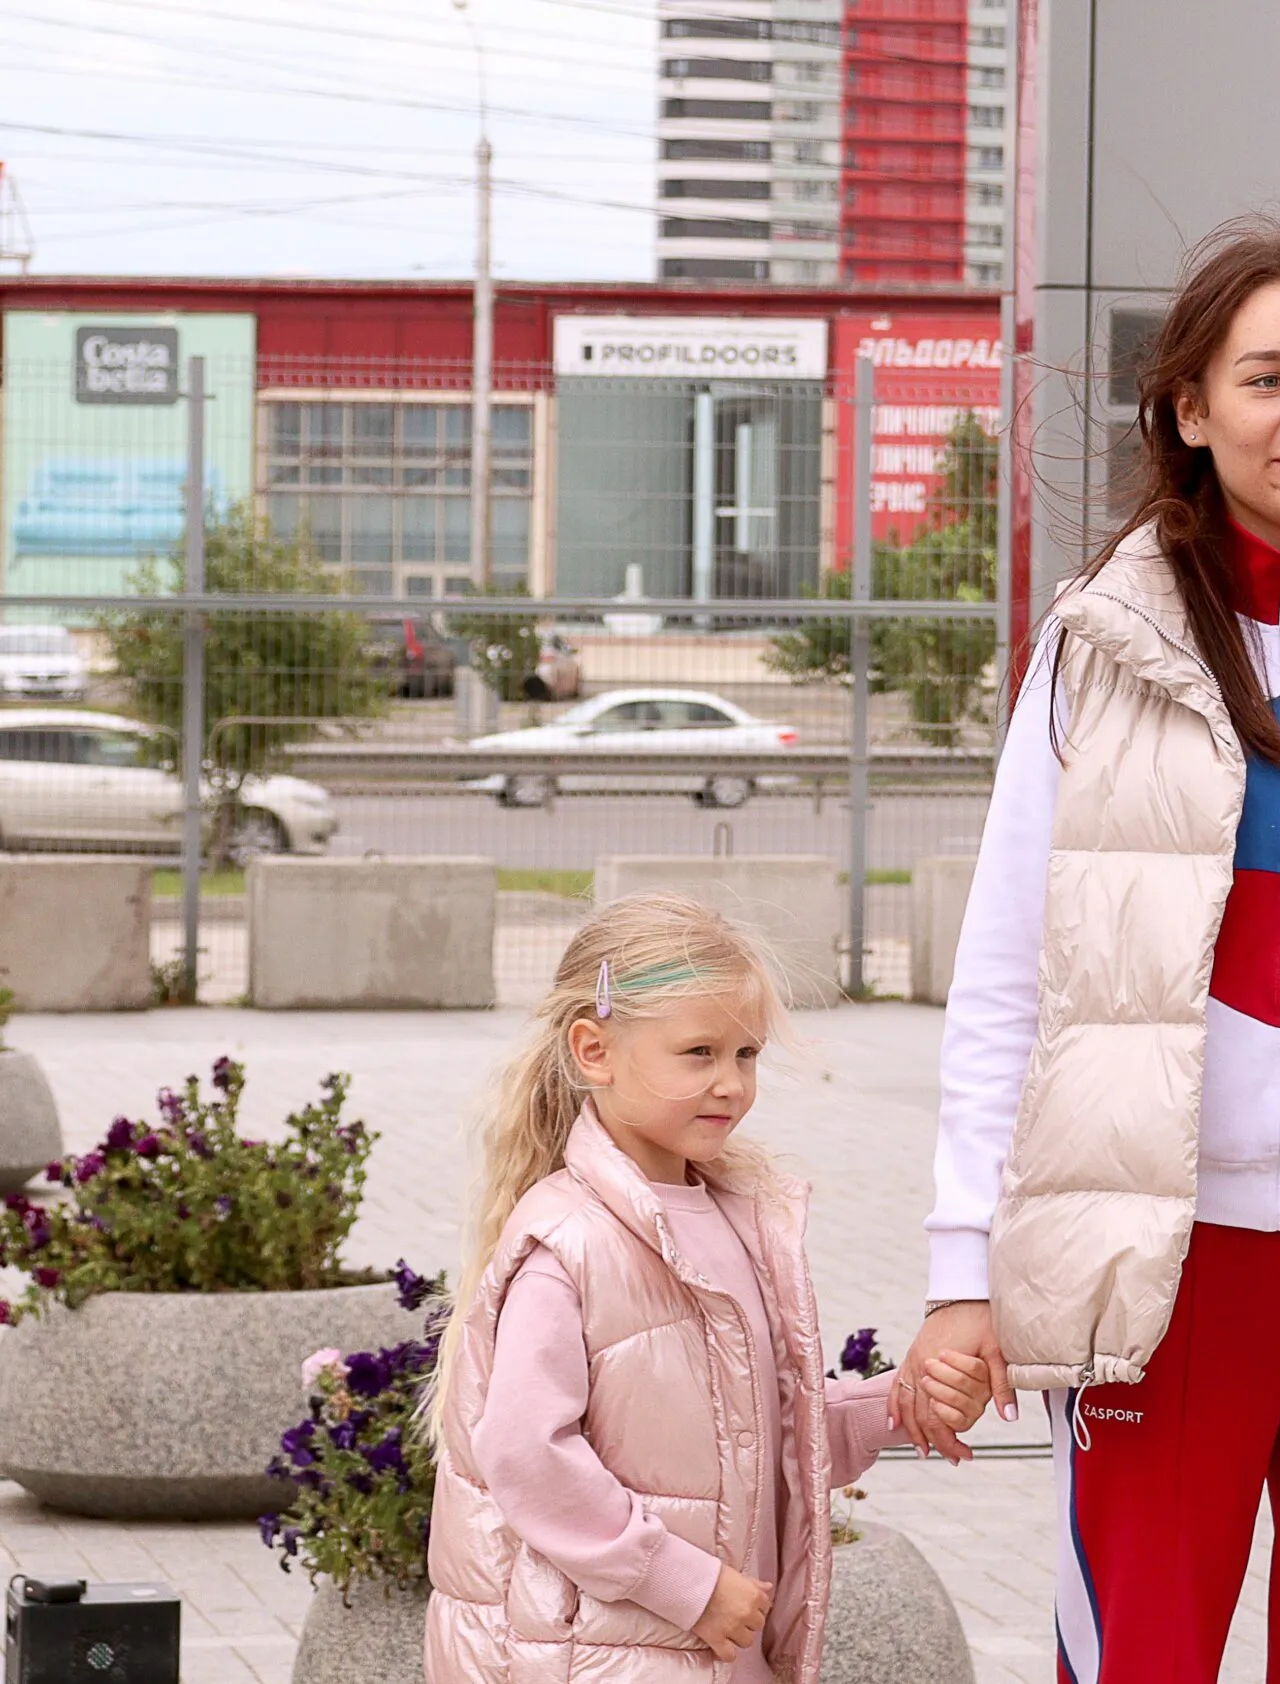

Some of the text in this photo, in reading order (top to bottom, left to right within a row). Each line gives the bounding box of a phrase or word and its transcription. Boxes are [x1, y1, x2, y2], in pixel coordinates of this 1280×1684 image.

[83, 335, 169, 367] Costa
[601, 343, 797, 364] PROFILDOORS
[854, 337, 1003, 368] ЭЛЬДОРАД
[86, 365, 168, 393] bella
[1084, 1403, 1144, 1424] ZASPORT
